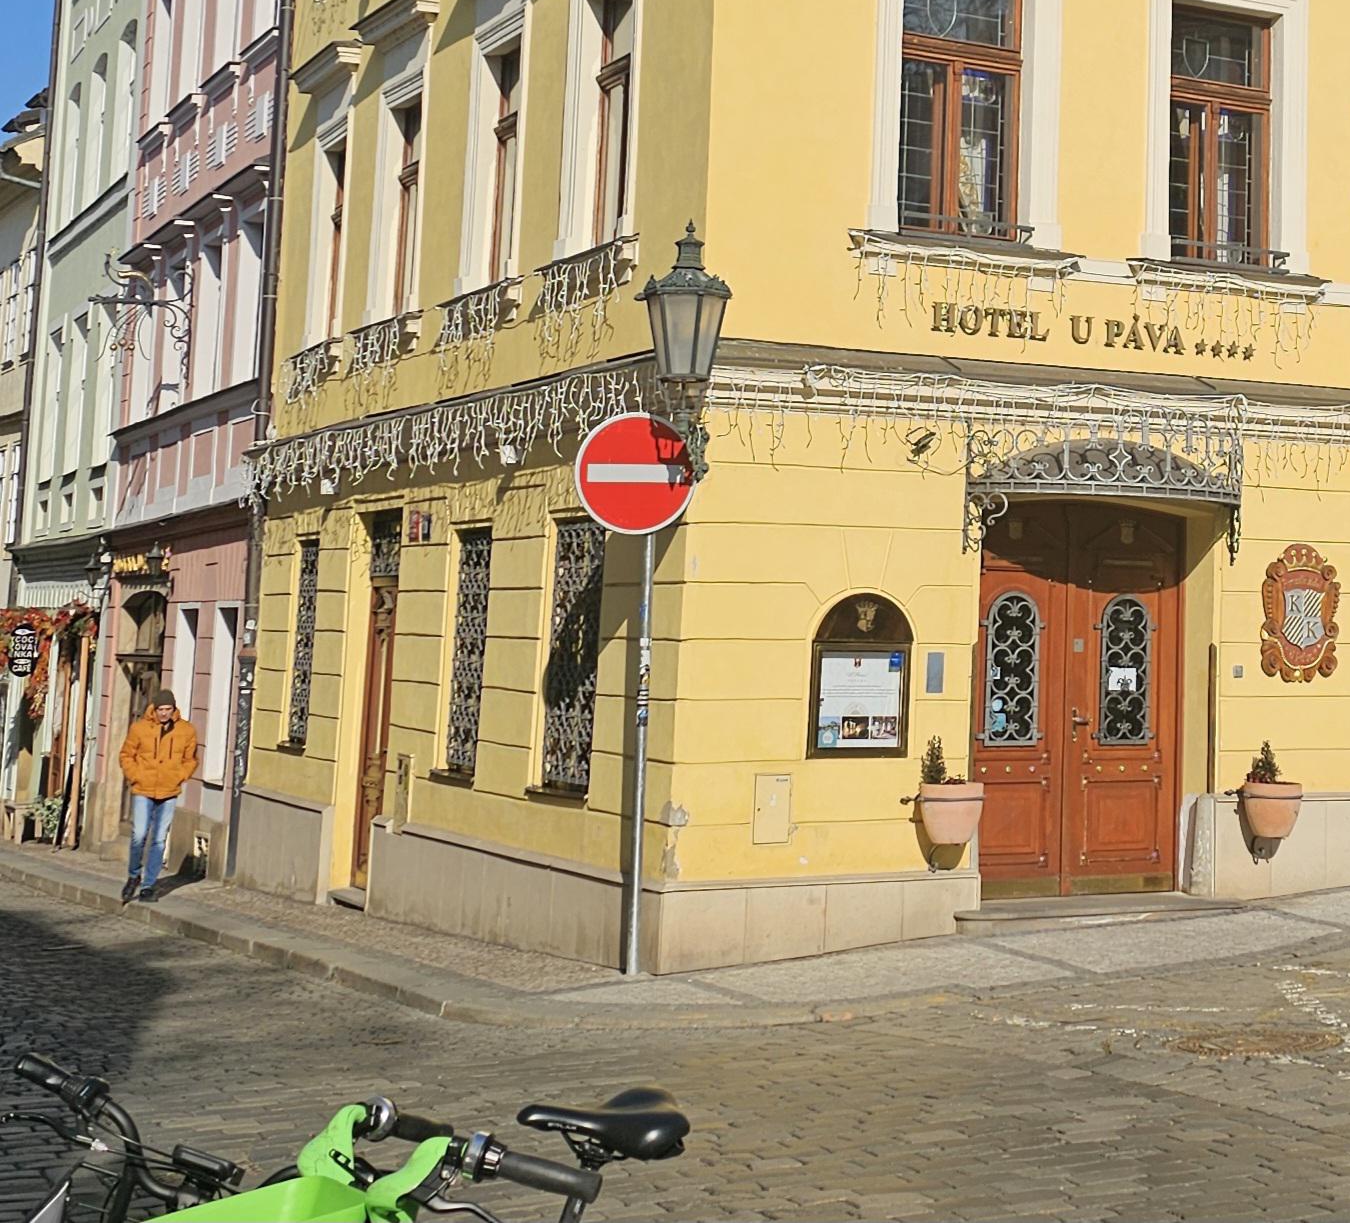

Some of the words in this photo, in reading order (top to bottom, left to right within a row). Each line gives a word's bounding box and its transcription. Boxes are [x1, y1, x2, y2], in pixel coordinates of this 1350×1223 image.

[930, 301, 1050, 342] HOTEL
[1071, 315, 1093, 345] U
[1104, 313, 1186, 355] PÁVA
[1289, 595, 1301, 614] K
[1306, 621, 1320, 639] K
